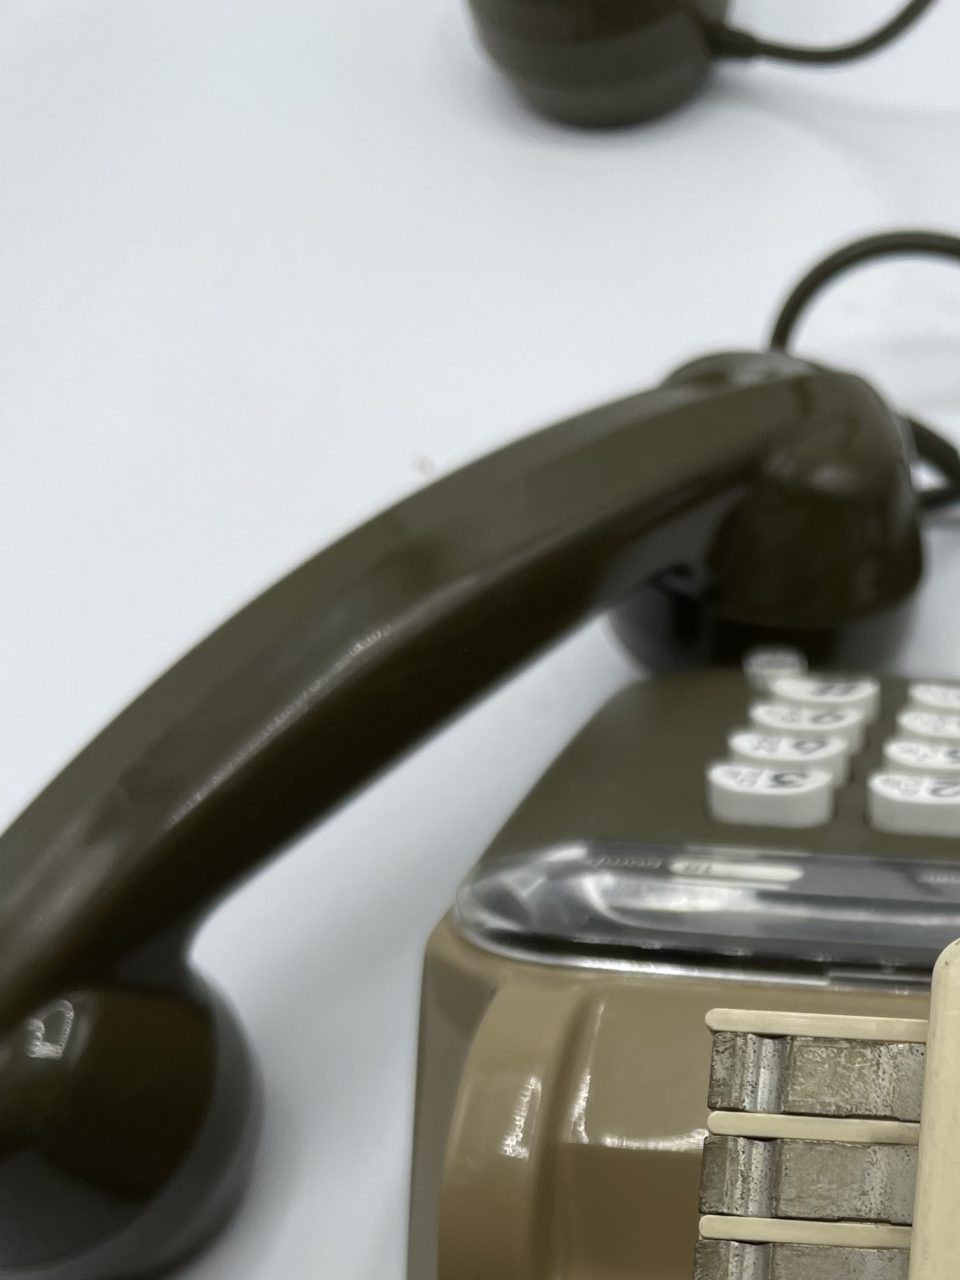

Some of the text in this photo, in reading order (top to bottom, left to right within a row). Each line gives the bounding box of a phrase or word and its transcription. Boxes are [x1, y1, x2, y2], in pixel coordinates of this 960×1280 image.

[809, 710, 844, 726] 9
[794, 738, 827, 754] 6
[769, 772, 808, 788] 3
